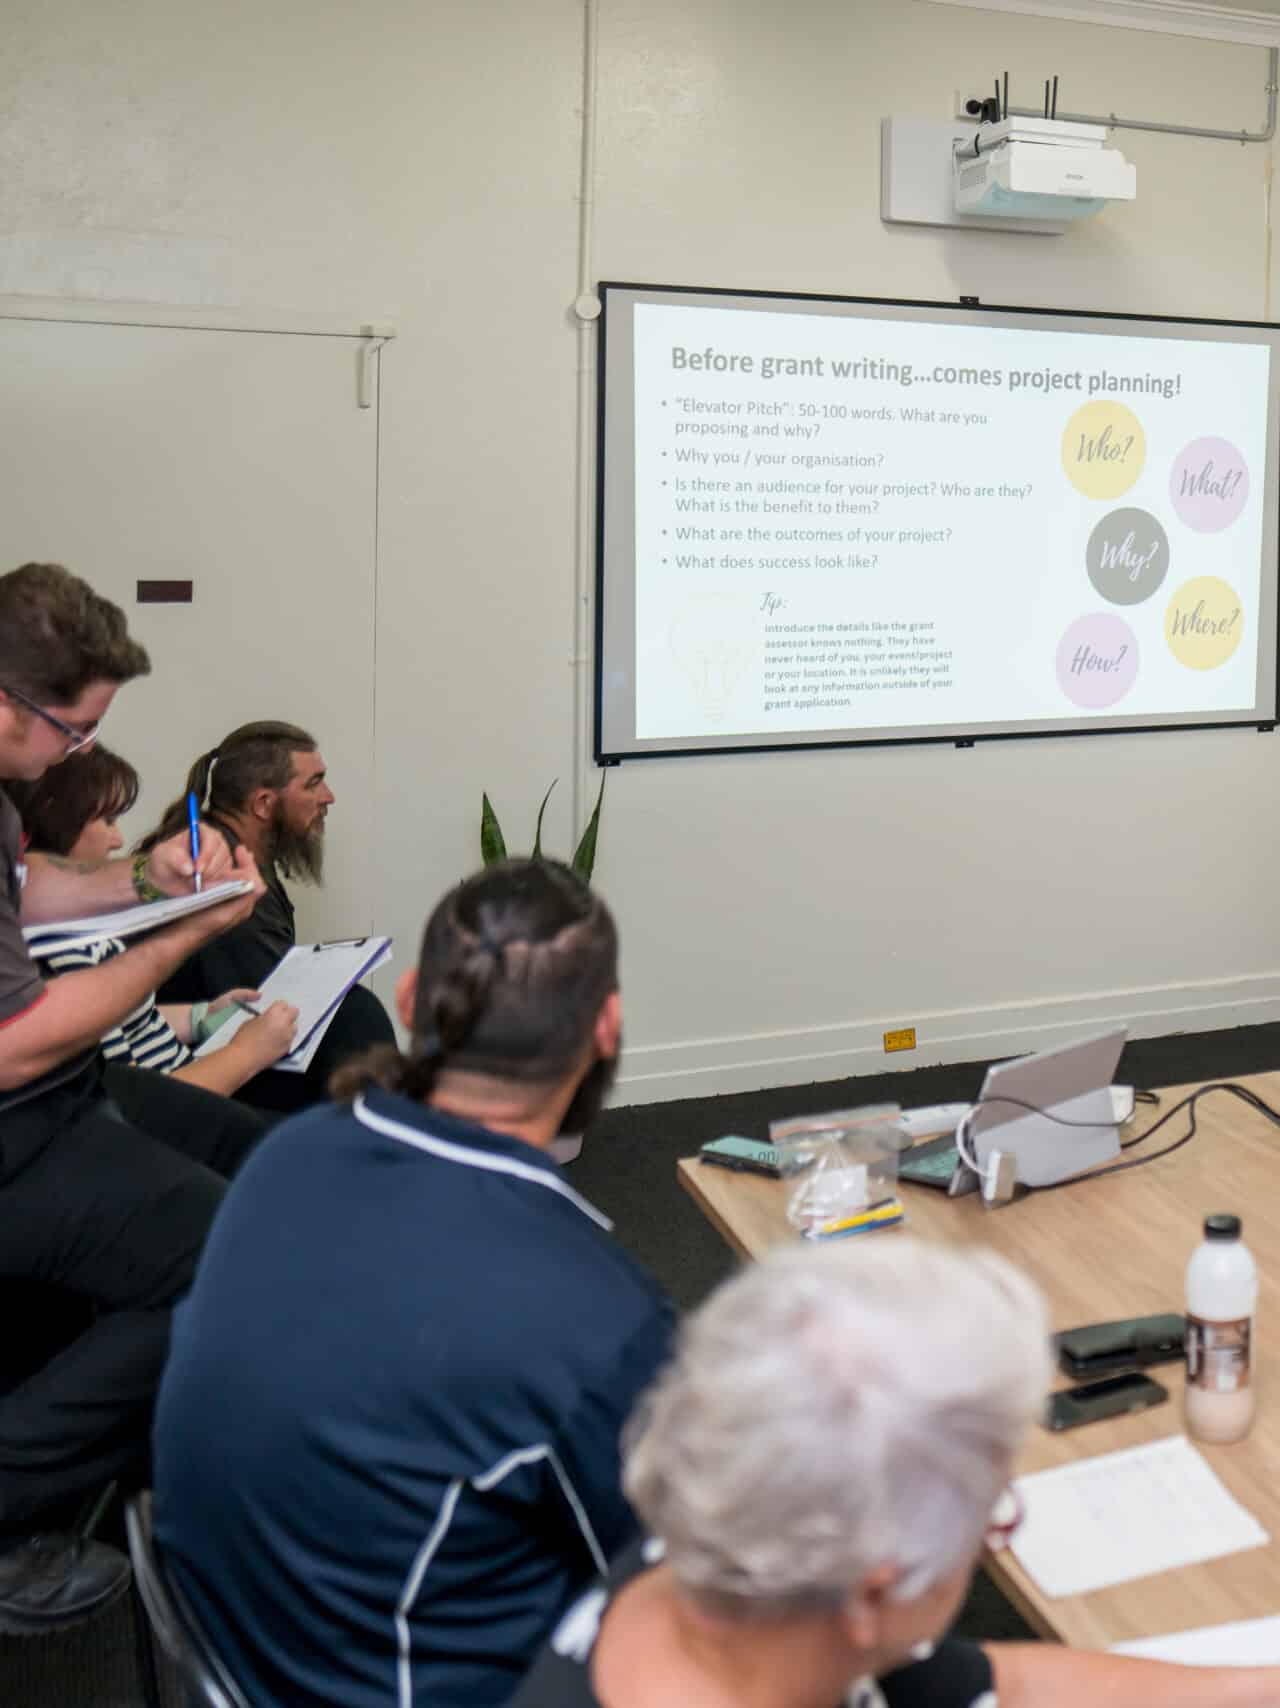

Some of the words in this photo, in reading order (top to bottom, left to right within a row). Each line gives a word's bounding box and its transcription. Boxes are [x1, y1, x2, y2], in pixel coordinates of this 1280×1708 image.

[671, 346, 753, 374] Before
[761, 356, 824, 379] grant
[1009, 367, 1083, 393] project
[1088, 370, 1181, 399] planning!
[799, 402, 848, 419] 50-100
[850, 406, 896, 421] words.
[899, 407, 936, 423] What
[938, 410, 961, 424] are
[963, 412, 988, 429] you
[675, 420, 749, 439] proposing
[753, 422, 780, 437] and
[783, 422, 821, 440] why?
[1077, 424, 1134, 464] Who?
[674, 447, 709, 465] Why
[713, 451, 740, 468] you
[744, 448, 751, 467] /
[754, 452, 787, 468] your
[791, 451, 885, 470] organisation?
[675, 478, 687, 492] Is
[691, 477, 731, 492] there
[735, 481, 753, 493] an
[758, 478, 821, 495] audience
[824, 479, 844, 494] for
[848, 482, 879, 498] your
[883, 481, 937, 500] project?
[940, 482, 971, 497] Who
[973, 486, 995, 497] are
[997, 483, 1033, 501] they?
[1180, 459, 1243, 500] What?
[675, 497, 716, 513] What
[720, 499, 730, 513] is
[735, 497, 759, 513] the
[763, 497, 813, 514] benefit
[817, 499, 832, 514] to
[835, 498, 880, 515] them?
[675, 526, 716, 542] What
[720, 531, 743, 542] are
[747, 527, 770, 542] the
[775, 529, 844, 542] outcomes
[847, 527, 861, 542] of
[864, 530, 895, 545] your
[898, 527, 953, 545] project?
[675, 553, 716, 569] What
[720, 554, 754, 569] does
[759, 557, 810, 569] success
[815, 553, 846, 569] look
[847, 553, 880, 569] like?
[1100, 531, 1159, 582] Why?
[1171, 599, 1240, 637] Where?
[1069, 645, 1129, 676] How?
